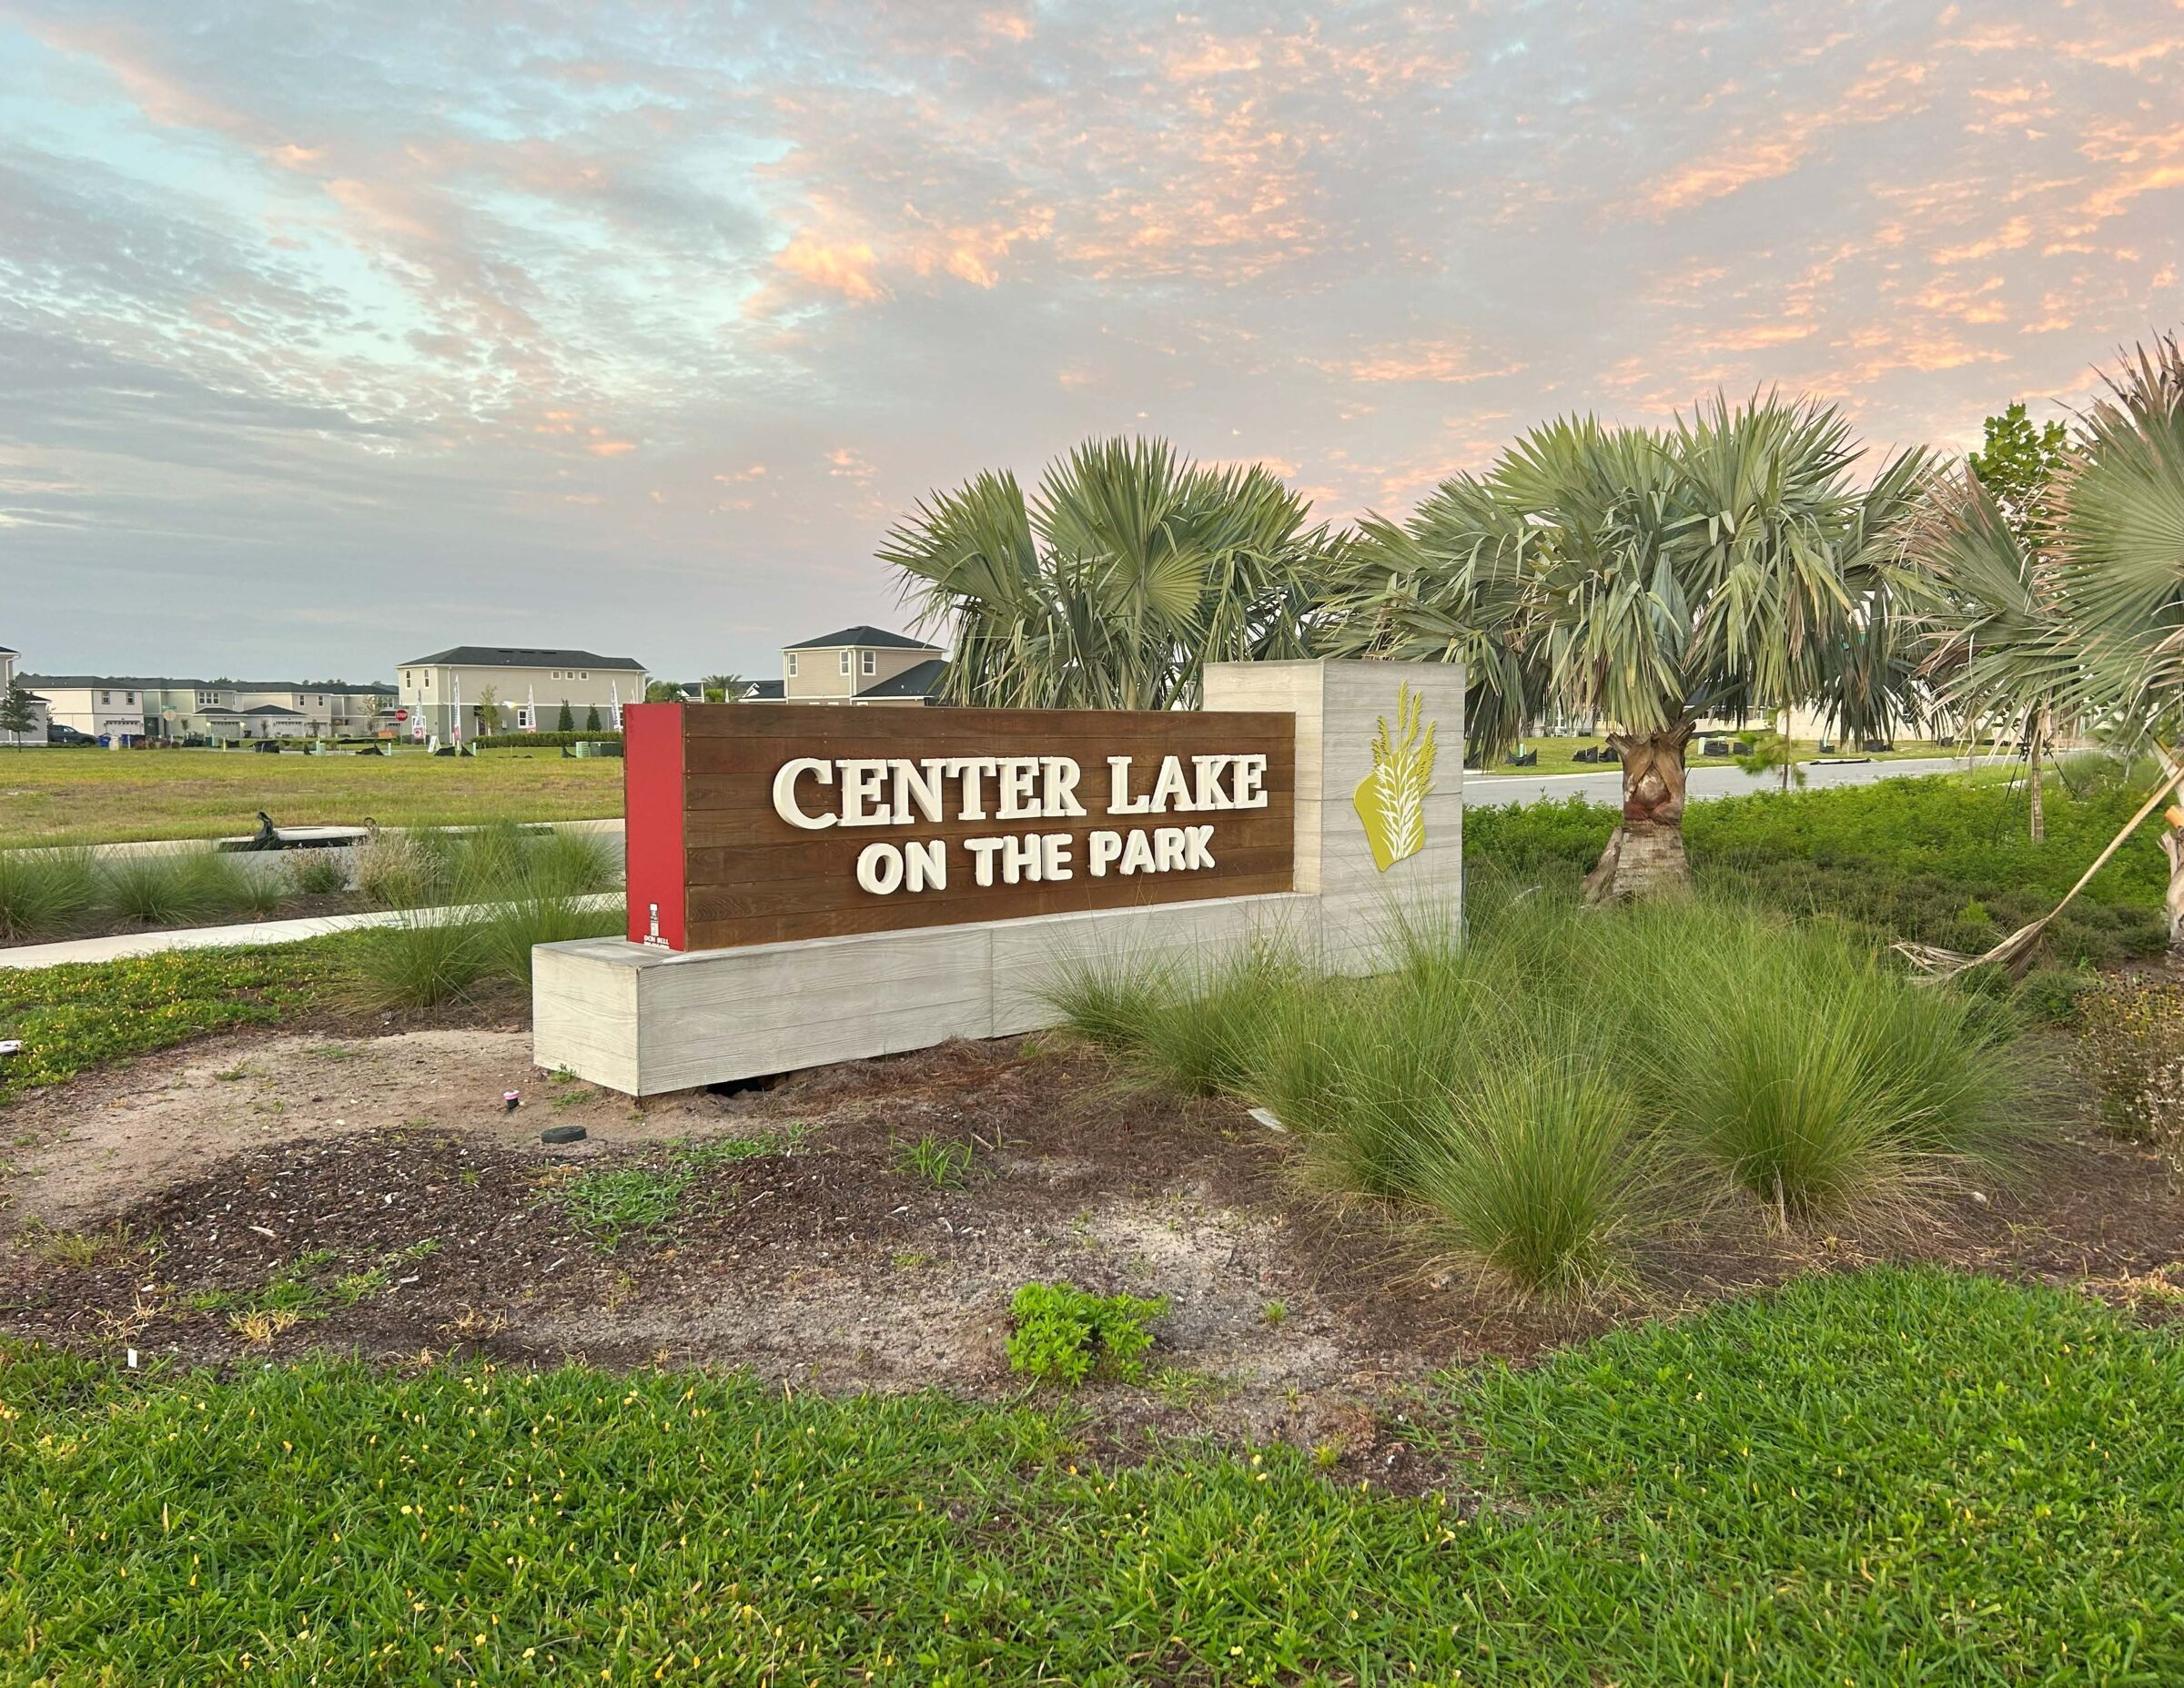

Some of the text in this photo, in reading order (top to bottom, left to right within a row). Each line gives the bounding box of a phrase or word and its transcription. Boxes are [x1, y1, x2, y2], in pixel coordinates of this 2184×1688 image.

[773, 753, 1269, 830] CENTER LAKE
[856, 824, 1216, 895] ON THE PARK
[643, 935, 656, 943] DON
